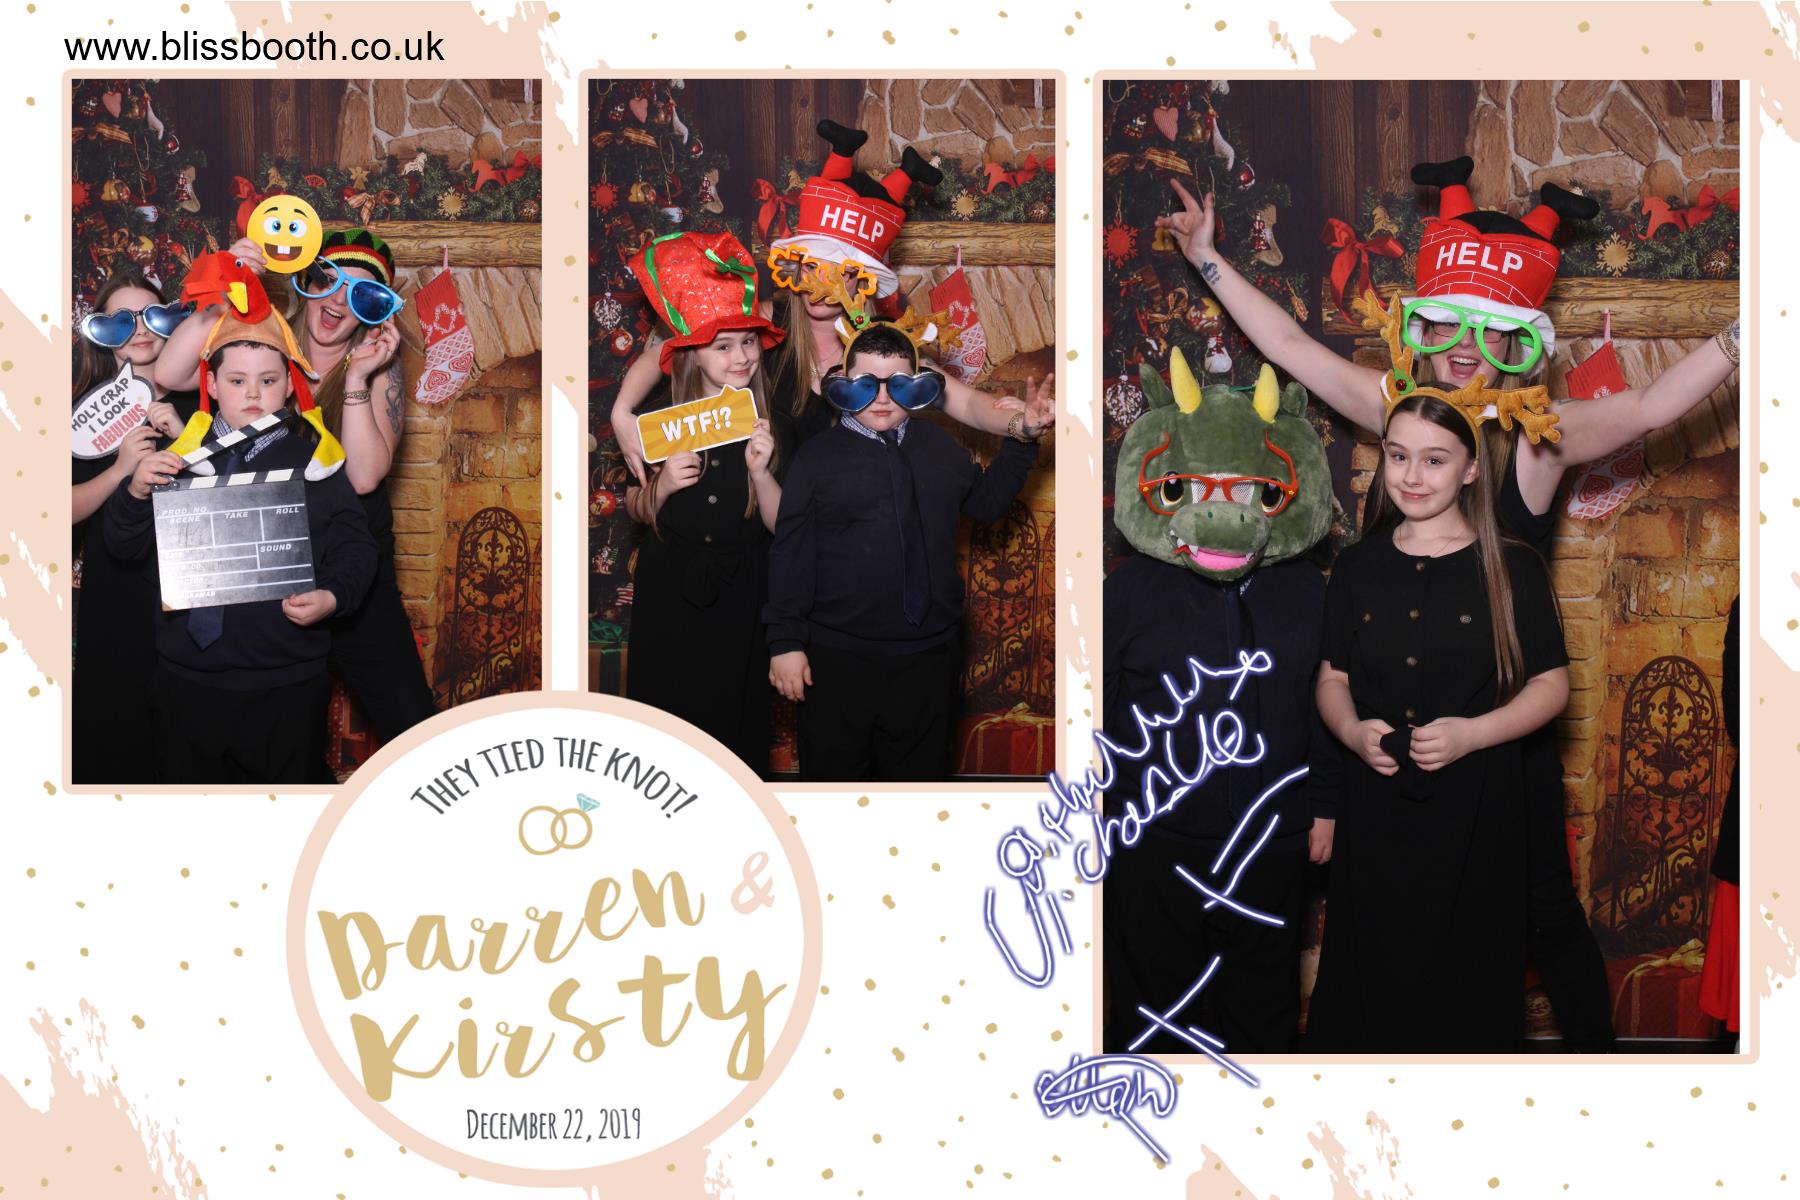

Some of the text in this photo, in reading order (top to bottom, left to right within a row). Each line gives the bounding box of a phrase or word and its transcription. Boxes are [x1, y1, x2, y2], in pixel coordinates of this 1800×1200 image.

[820, 204, 885, 243] HELP
[1436, 241, 1523, 275] HELP
[72, 377, 129, 432] HOLY CRAP
[88, 397, 130, 434] I LOOK
[91, 403, 148, 453] FABULOUS
[660, 406, 732, 442] WTF!?
[224, 511, 249, 520] TAKE
[275, 506, 300, 515] ROLL
[260, 543, 292, 553] SOUND
